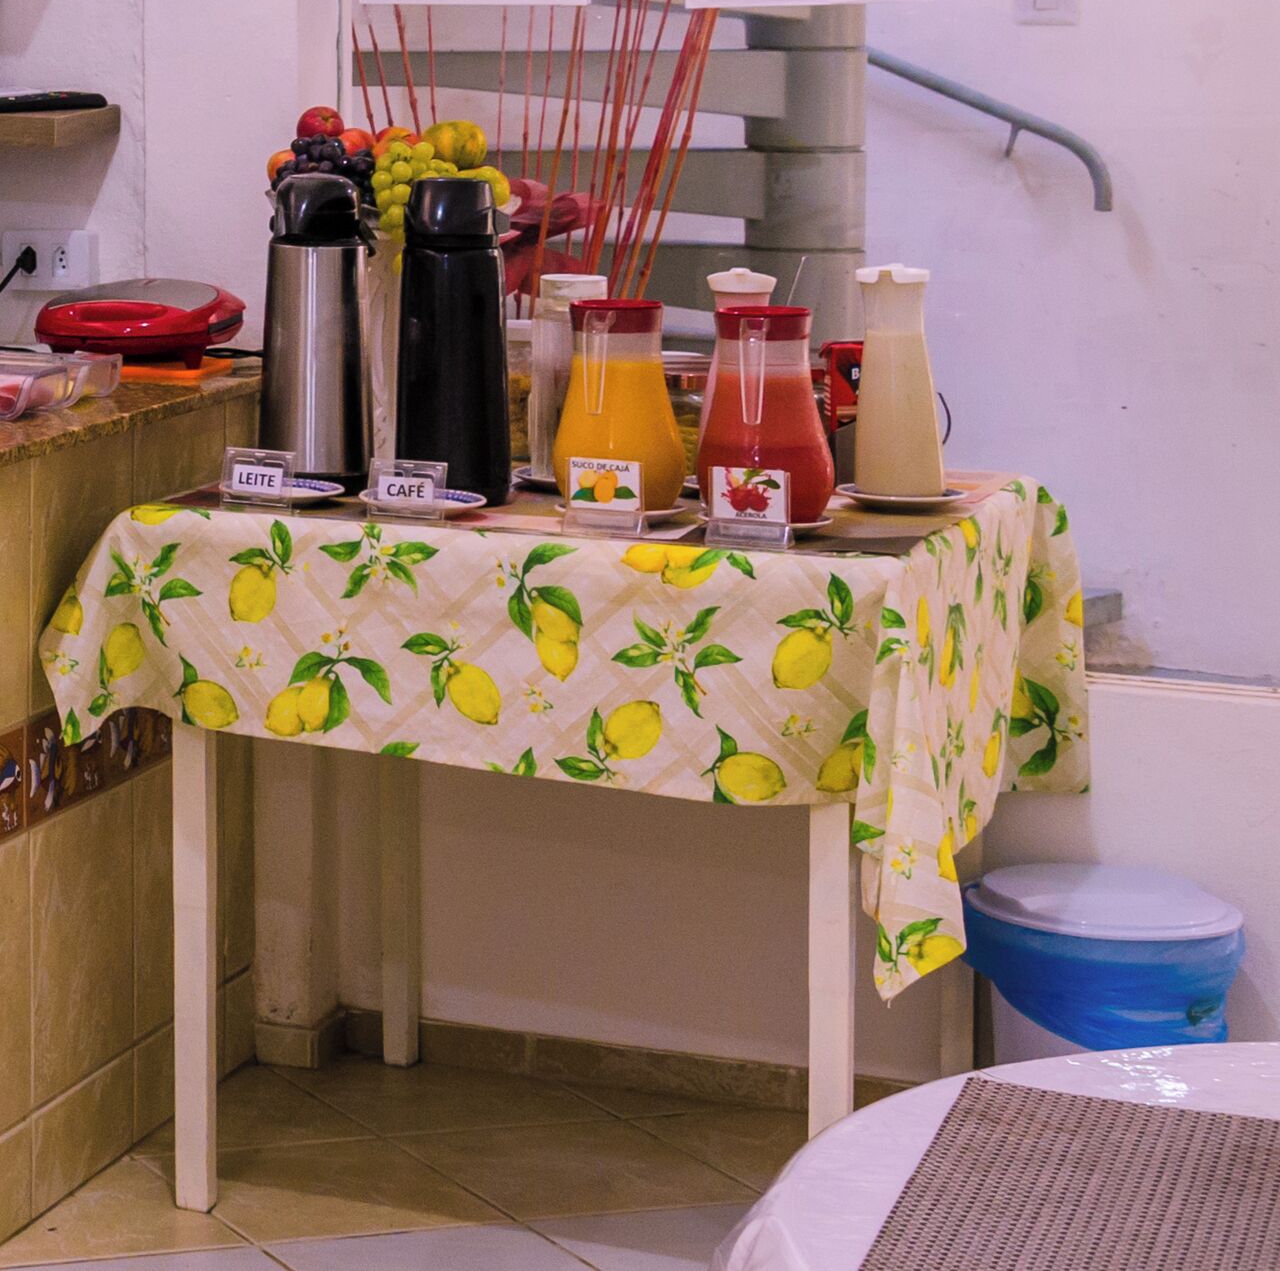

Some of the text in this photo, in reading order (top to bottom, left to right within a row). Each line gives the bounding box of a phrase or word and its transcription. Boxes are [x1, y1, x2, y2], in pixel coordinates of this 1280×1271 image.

[571, 461, 630, 473] SUCO DE CAJÁ
[238, 471, 276, 488] LEITE
[386, 482, 425, 499] CAFÉ
[734, 511, 767, 520] ACEROLA
